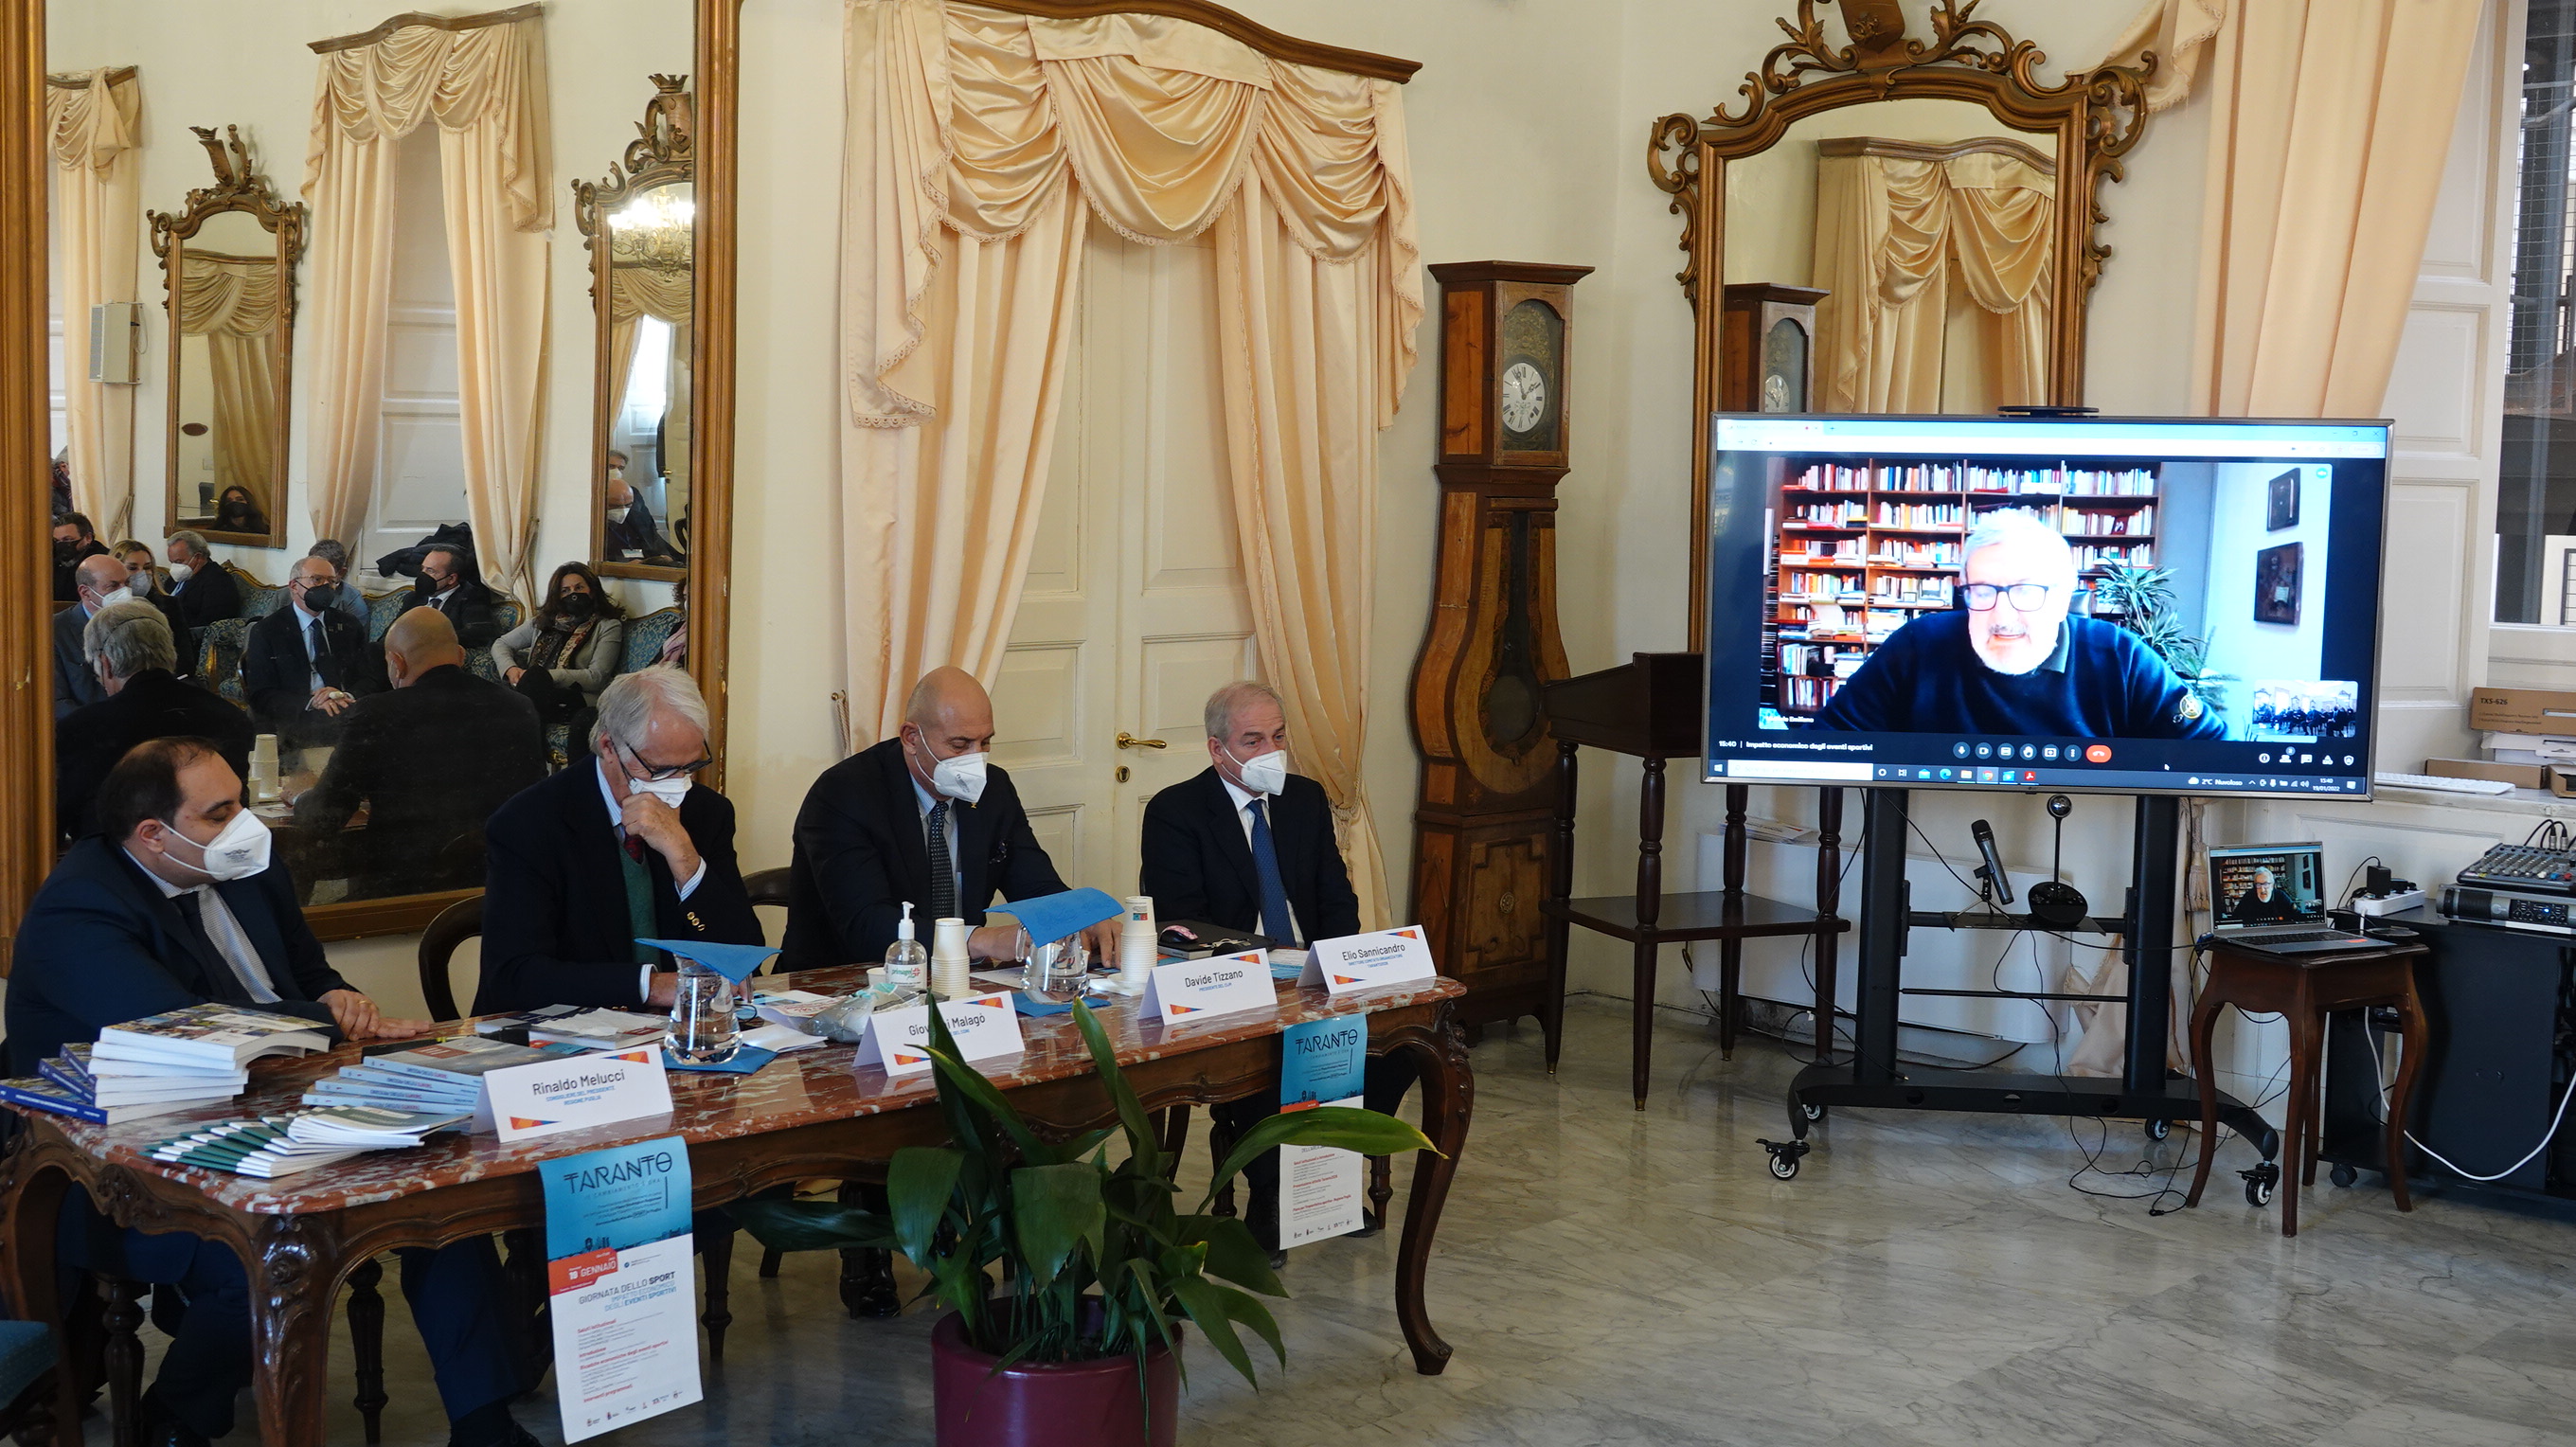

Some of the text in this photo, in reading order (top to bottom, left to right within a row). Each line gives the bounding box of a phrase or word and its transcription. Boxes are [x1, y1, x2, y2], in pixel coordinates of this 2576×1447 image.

[1745, 741, 1772, 749] Impatto
[1772, 742, 1809, 751] economico
[1809, 742, 1826, 751] degli
[1847, 743, 1874, 752] sportivi
[1342, 943, 1406, 961] Elio Sannicandro
[1185, 969, 1244, 989] Davide Tizzano
[908, 1019, 951, 1036] Giovi
[1296, 1028, 1357, 1055] TARANTO
[532, 1068, 626, 1096] Rinaldo Melucci
[564, 1152, 672, 1194] TARANTO
[580, 1259, 617, 1278] GENNAIO
[579, 1271, 676, 1305] GIORNATA DELLO SPORT
